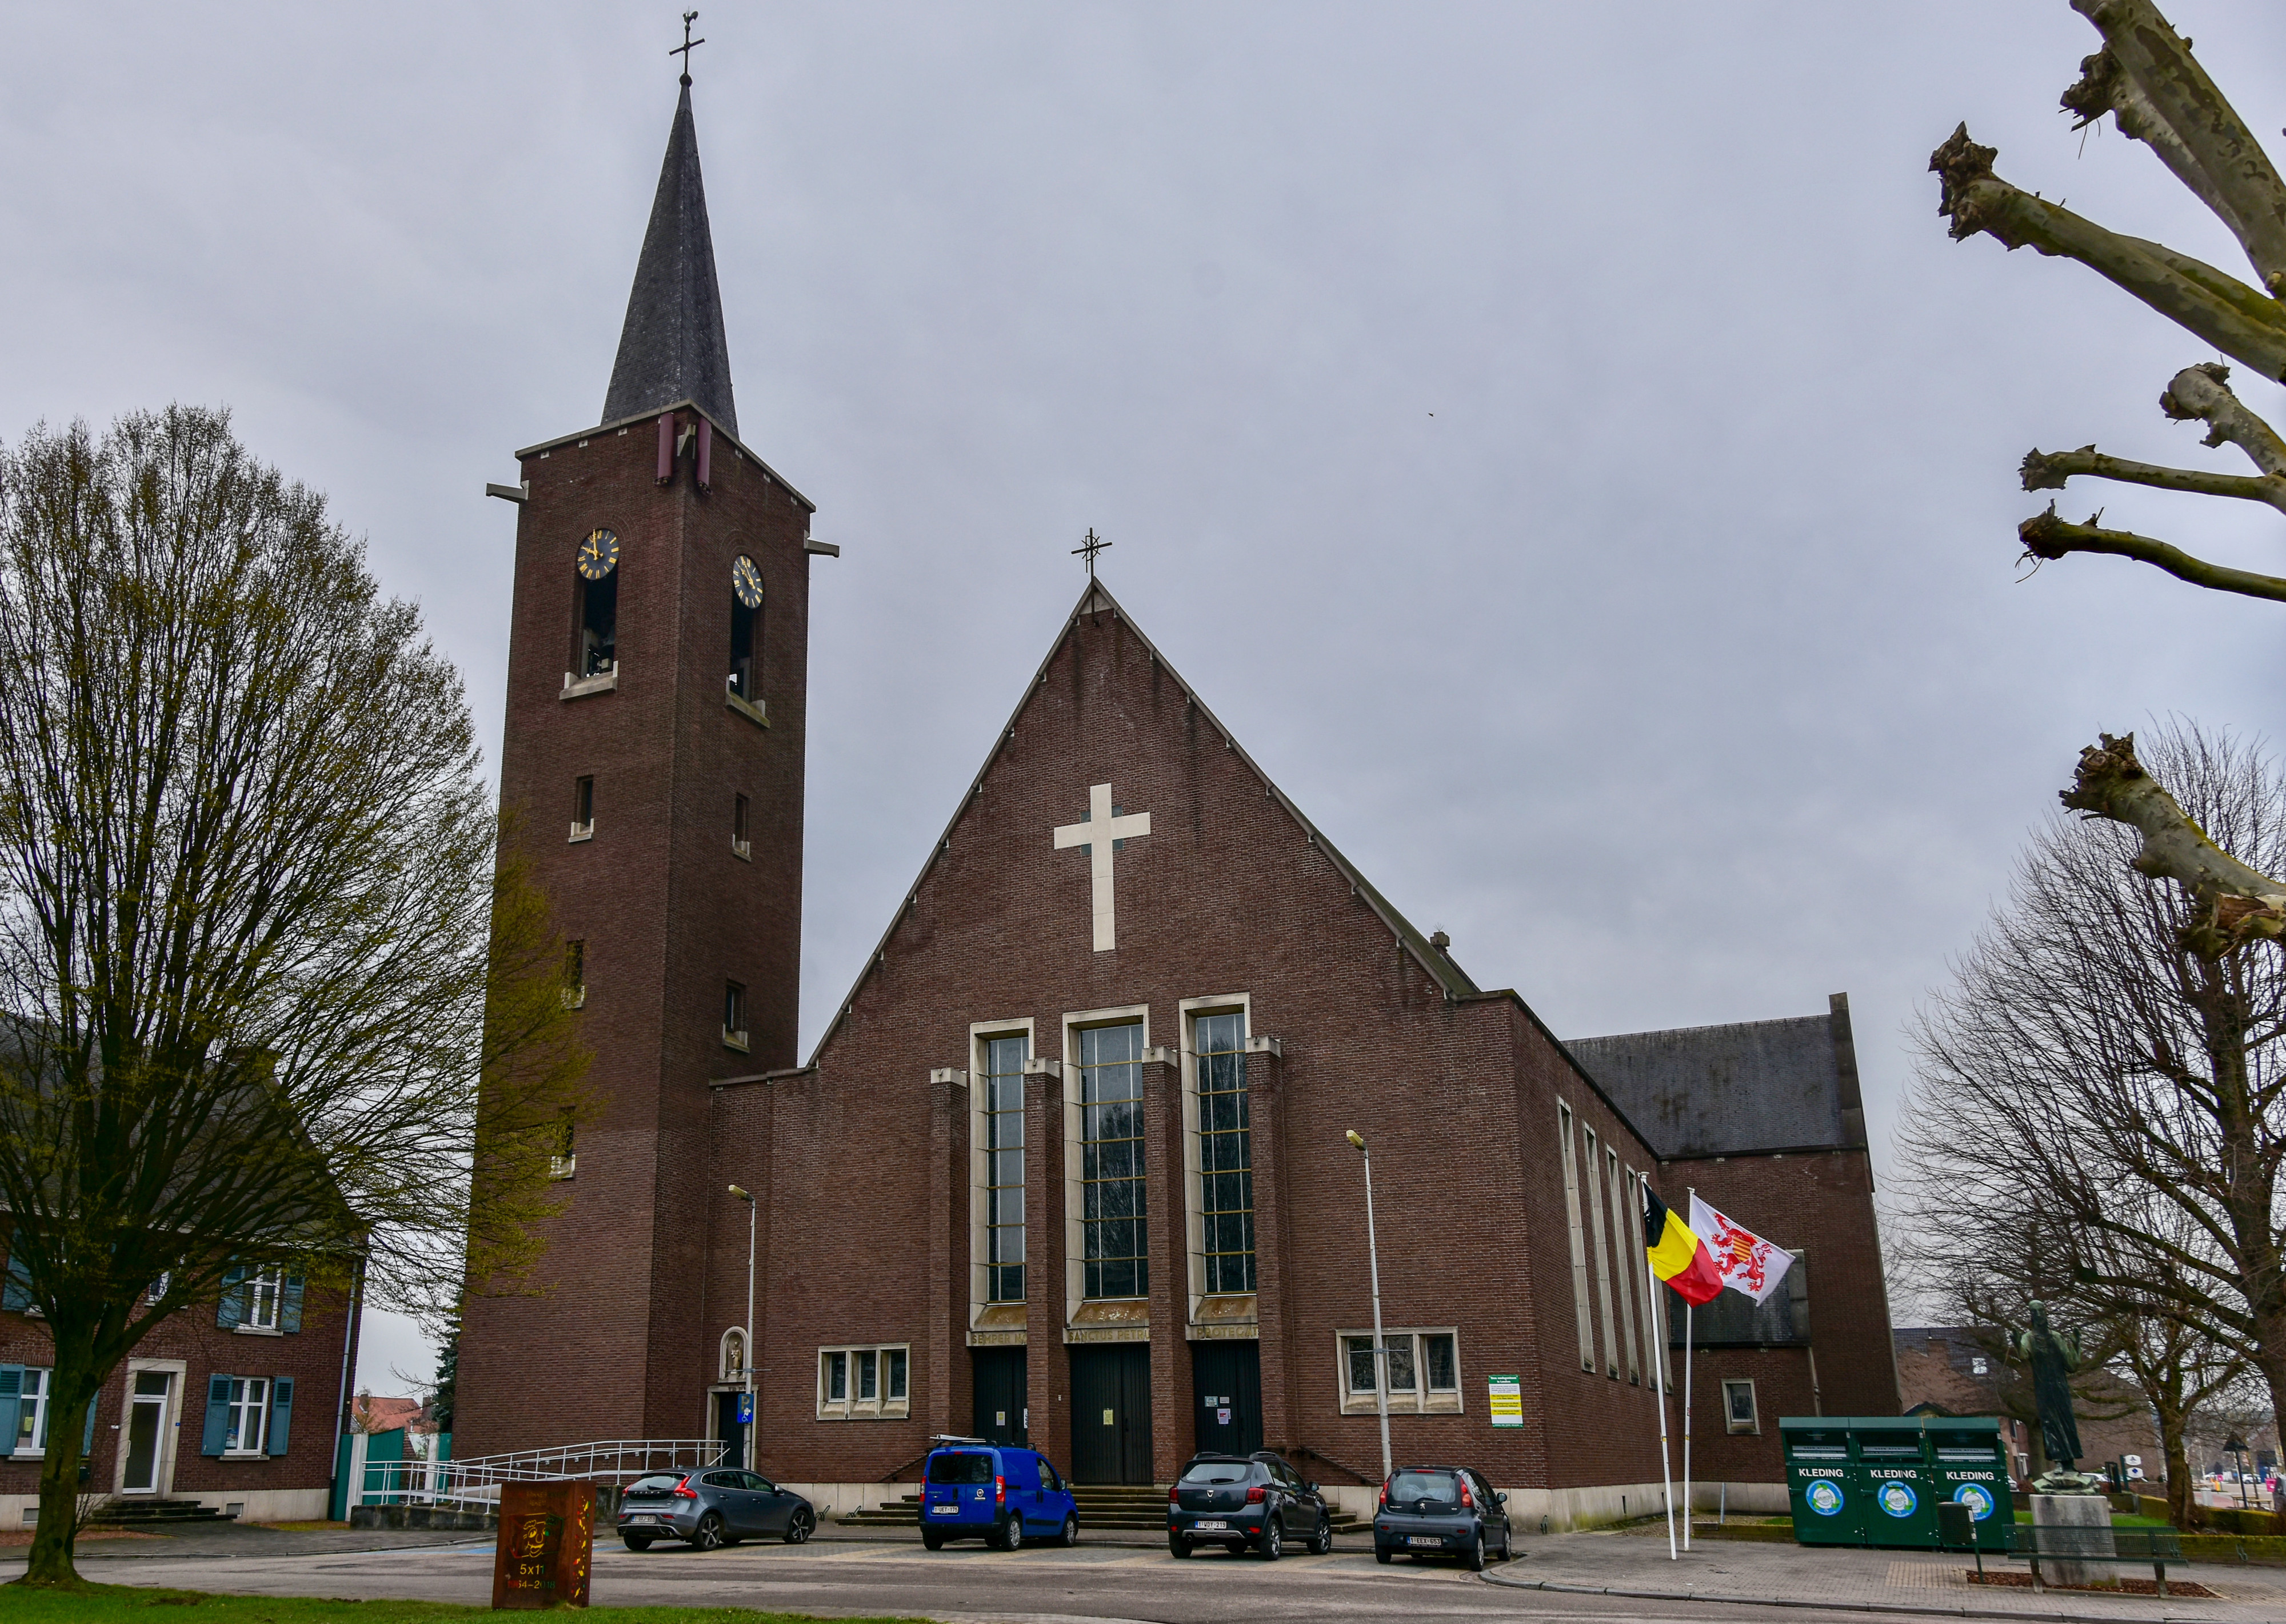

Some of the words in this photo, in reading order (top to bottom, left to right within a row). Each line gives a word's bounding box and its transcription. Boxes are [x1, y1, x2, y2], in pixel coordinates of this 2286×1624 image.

[1068, 1331, 1113, 1341] SANCTUS
[1197, 1326, 1258, 1338] PROTEGAT
[972, 1334, 1010, 1343] SEMPER
[1799, 1468, 1844, 1477] KLEDING
[1870, 1469, 1917, 1478] KLEDING
[1946, 1471, 1995, 1480] KLEDING
[519, 1564, 544, 1575] 5x11
